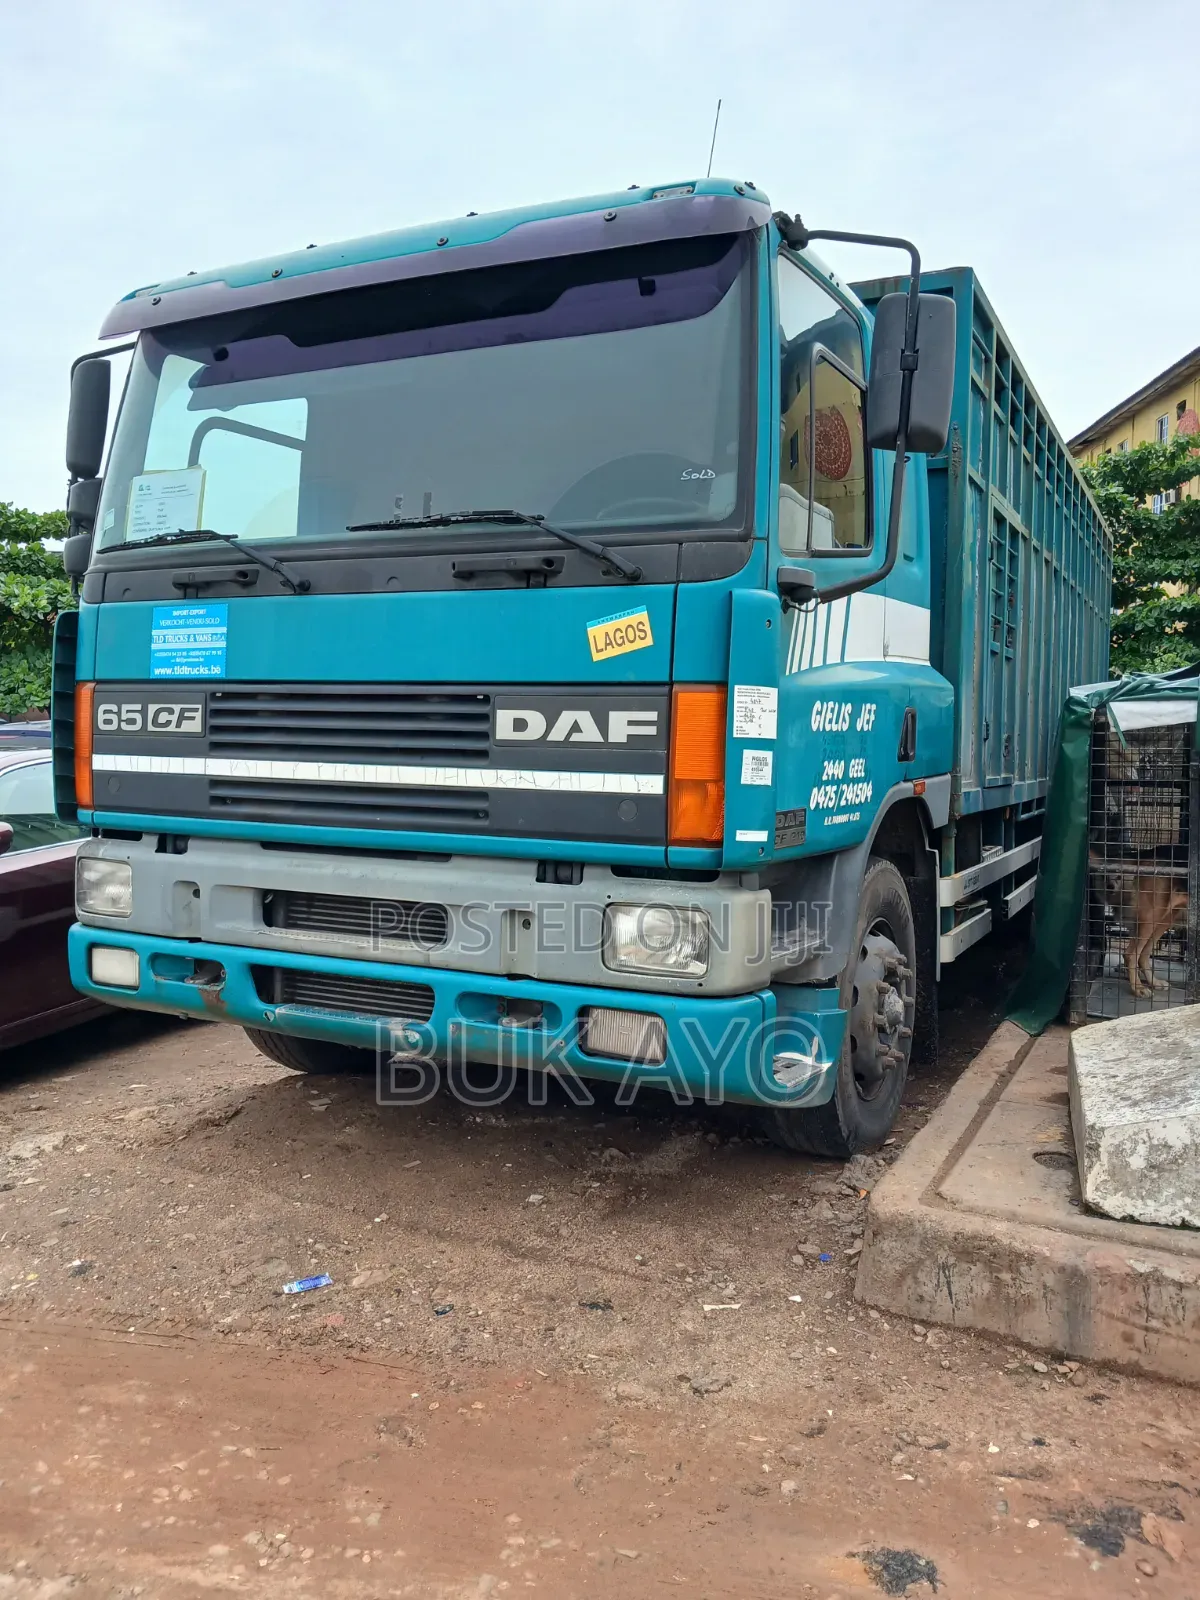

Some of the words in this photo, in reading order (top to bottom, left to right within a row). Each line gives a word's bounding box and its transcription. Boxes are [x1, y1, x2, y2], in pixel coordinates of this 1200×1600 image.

[153, 635, 165, 643] TLD
[165, 634, 188, 643] TRUCKS
[189, 634, 195, 642] &
[195, 633, 212, 642] VANS
[593, 621, 648, 653] LAGOS
[154, 665, 221, 675] www.tldtrucks.be
[97, 703, 143, 731] 65
[151, 706, 200, 729] CF
[496, 709, 658, 743] DAF
[811, 700, 852, 732] GIELIS
[856, 703, 877, 732] JEF
[822, 759, 845, 781] 2440
[848, 757, 866, 778] GEEL
[809, 780, 873, 812] 0475/241504
[776, 811, 805, 828] DAF
